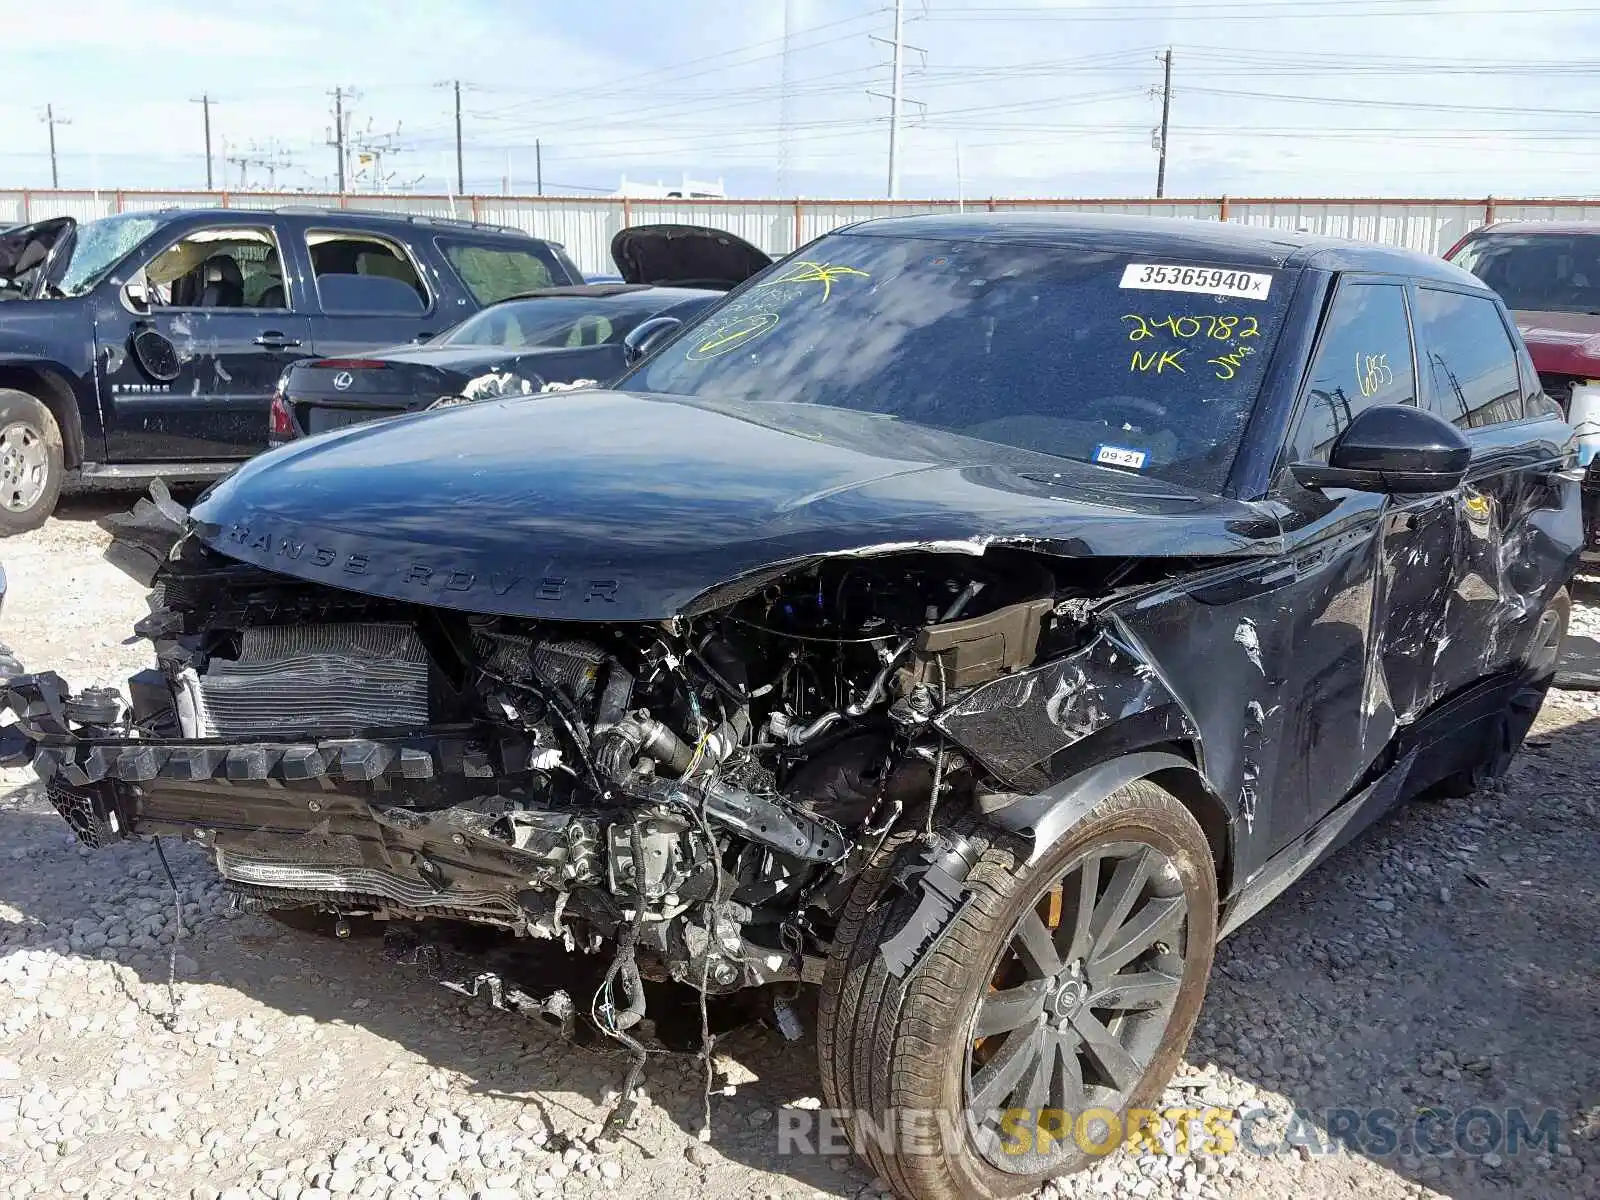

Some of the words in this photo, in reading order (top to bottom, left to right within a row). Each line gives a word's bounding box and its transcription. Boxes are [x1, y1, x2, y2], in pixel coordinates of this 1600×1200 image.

[1120, 314, 1261, 341] 240782
[1131, 348, 1187, 374] NK
[229, 520, 371, 576] RANGE
[402, 562, 620, 603] ROVER
